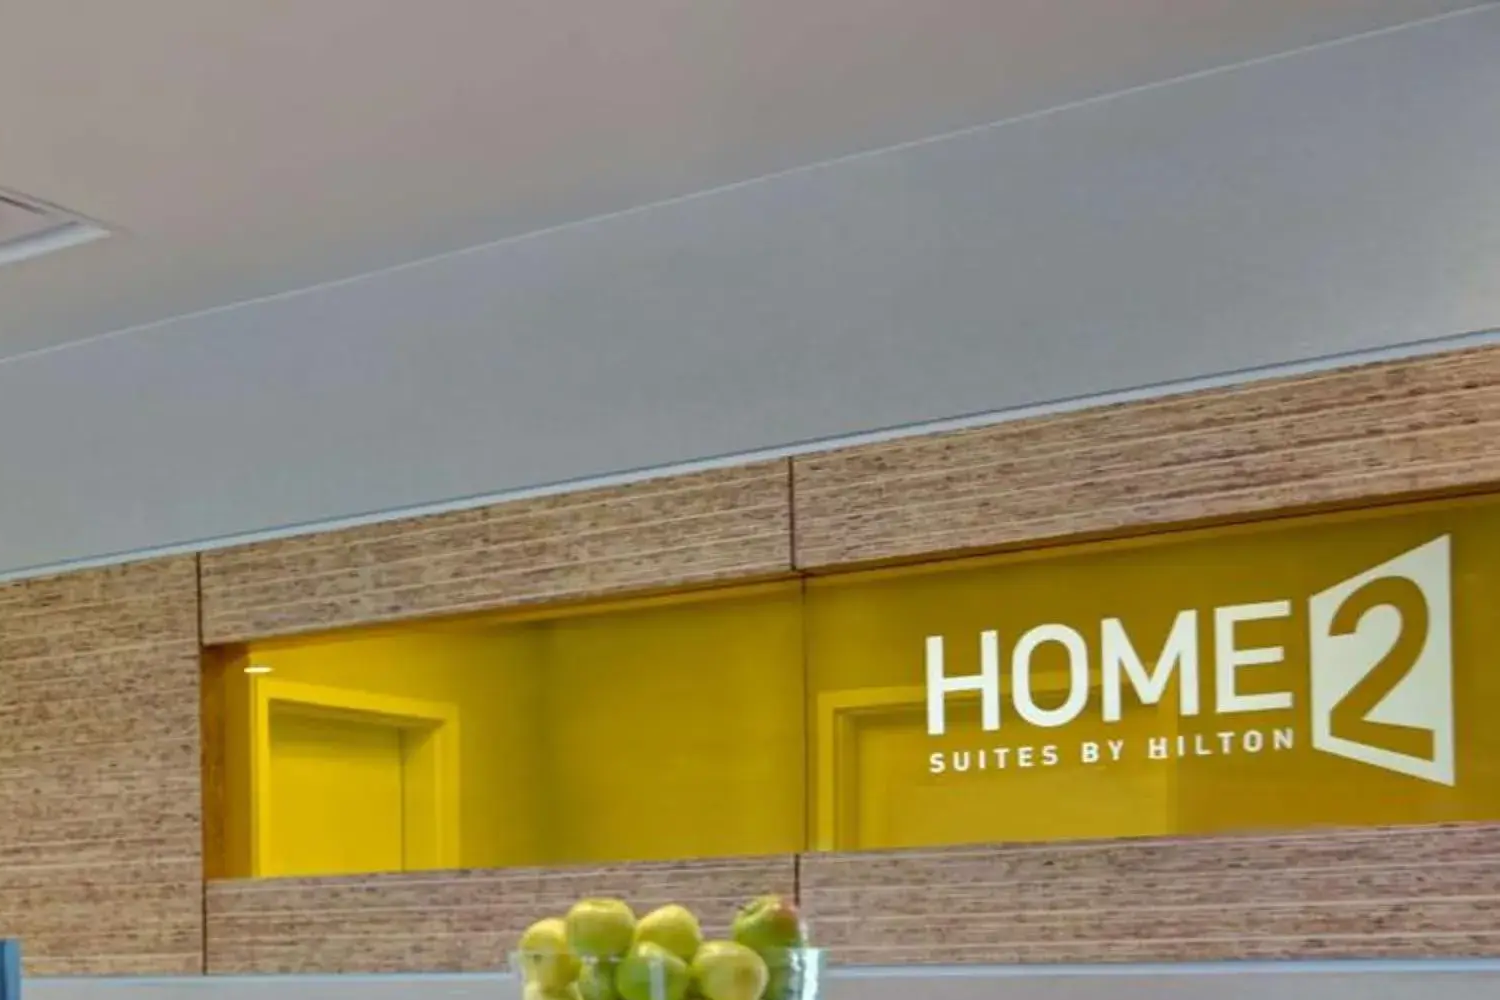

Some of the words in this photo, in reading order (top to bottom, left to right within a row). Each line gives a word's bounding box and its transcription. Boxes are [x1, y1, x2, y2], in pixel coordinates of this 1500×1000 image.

[925, 599, 1294, 736] HOME
[929, 744, 1060, 774] SUITES
[1080, 739, 1125, 764] BY
[1147, 728, 1295, 759] HILTON
